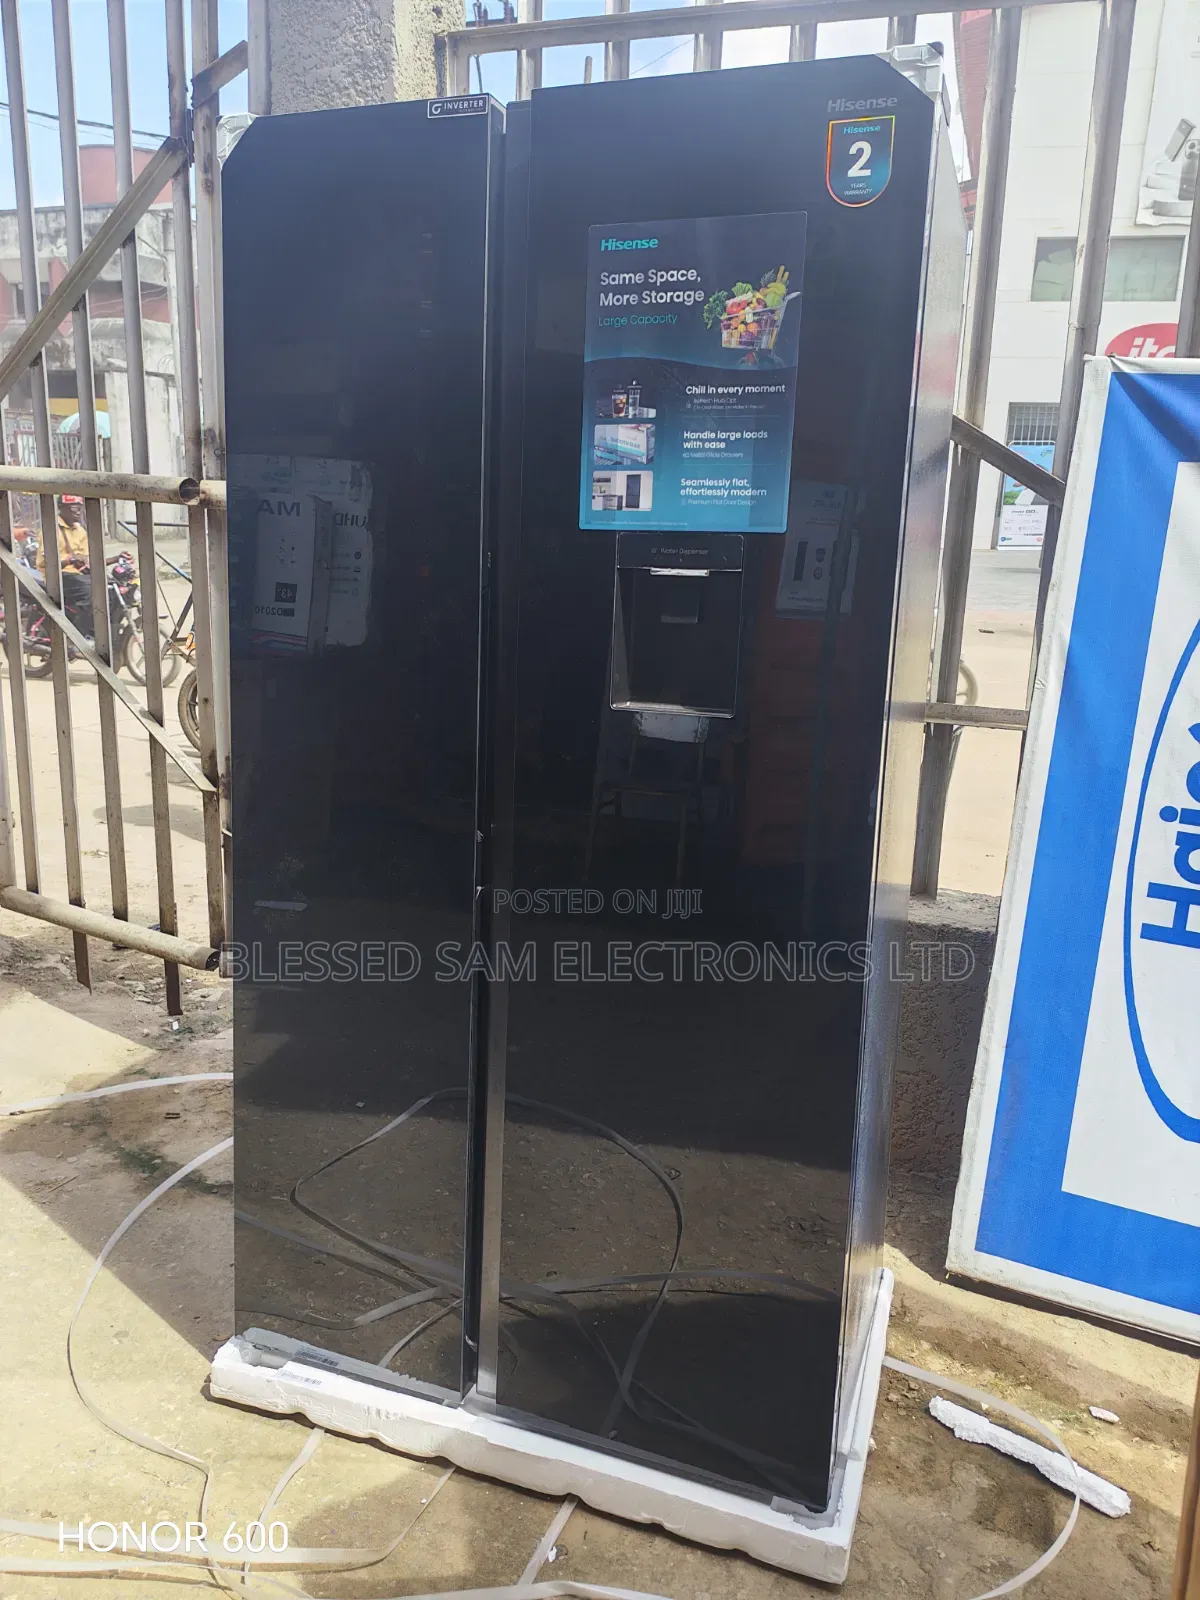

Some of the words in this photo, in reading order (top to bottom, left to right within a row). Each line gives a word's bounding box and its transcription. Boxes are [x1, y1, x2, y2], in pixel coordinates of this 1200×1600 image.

[443, 100, 484, 110] INVERTER
[827, 97, 898, 112] Hisense
[843, 125, 881, 134] Hisense
[847, 140, 872, 178] 2
[601, 237, 659, 251] Hisense
[600, 271, 645, 286] Same
[648, 267, 701, 286] Space,
[599, 292, 639, 307] More
[641, 288, 705, 306] Storage
[598, 314, 628, 328] Large
[630, 313, 678, 326] Capacity
[1128, 337, 1176, 358] it
[686, 385, 706, 395] Chill
[707, 385, 716, 394] in
[717, 386, 744, 396] every
[745, 384, 786, 393] moment
[683, 431, 715, 440] Handle
[717, 430, 742, 441] large
[743, 430, 768, 439] loads
[683, 440, 703, 449] with
[680, 478, 731, 488] Seamlessly
[732, 478, 750, 487] flat,
[680, 488, 729, 498] effortlessly
[730, 488, 767, 496] modern
[1140, 722, 1200, 949] Hai
